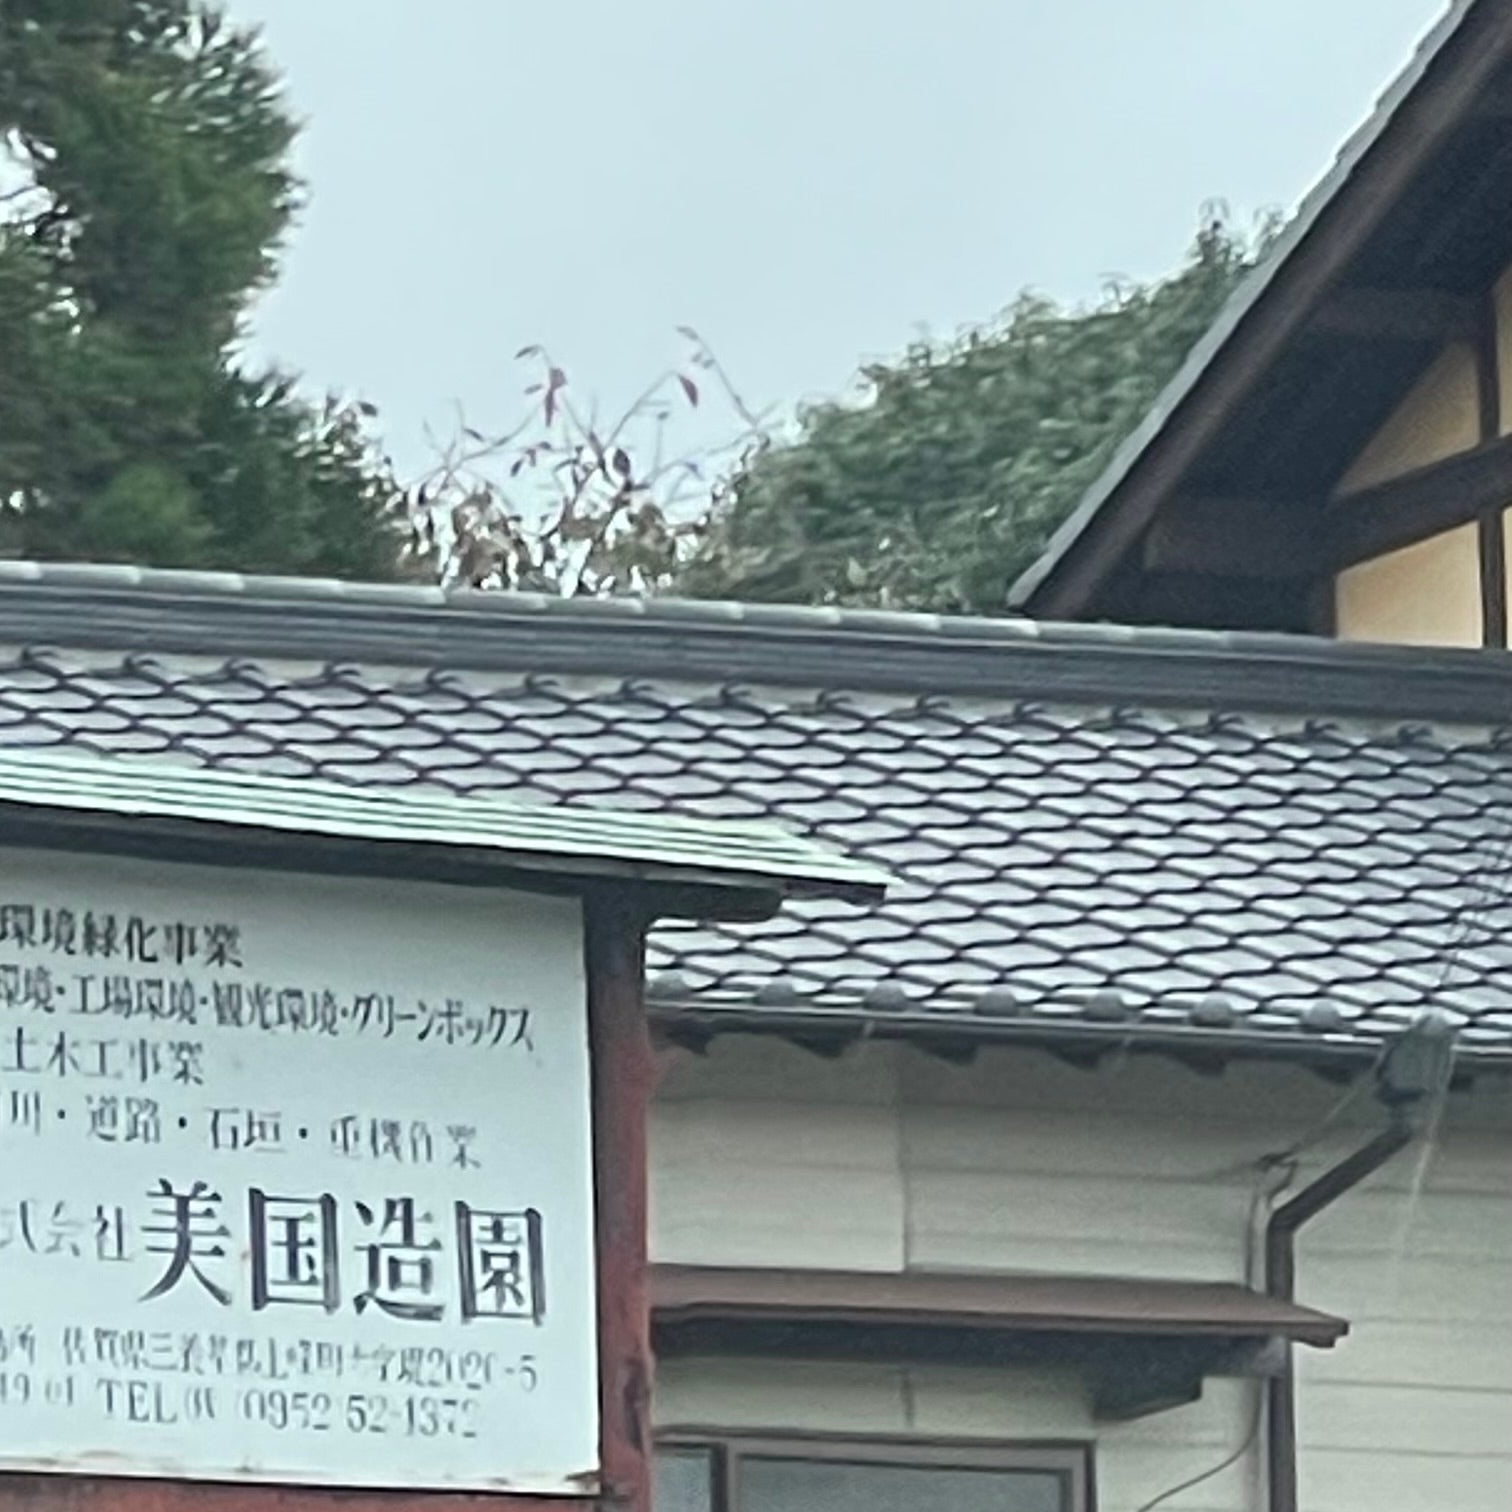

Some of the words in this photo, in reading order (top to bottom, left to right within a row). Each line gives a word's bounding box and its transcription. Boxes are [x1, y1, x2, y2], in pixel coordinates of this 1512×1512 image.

[0, 1026, 205, 1086] 土木工事業
[138, 1178, 545, 1326] 美国造園
